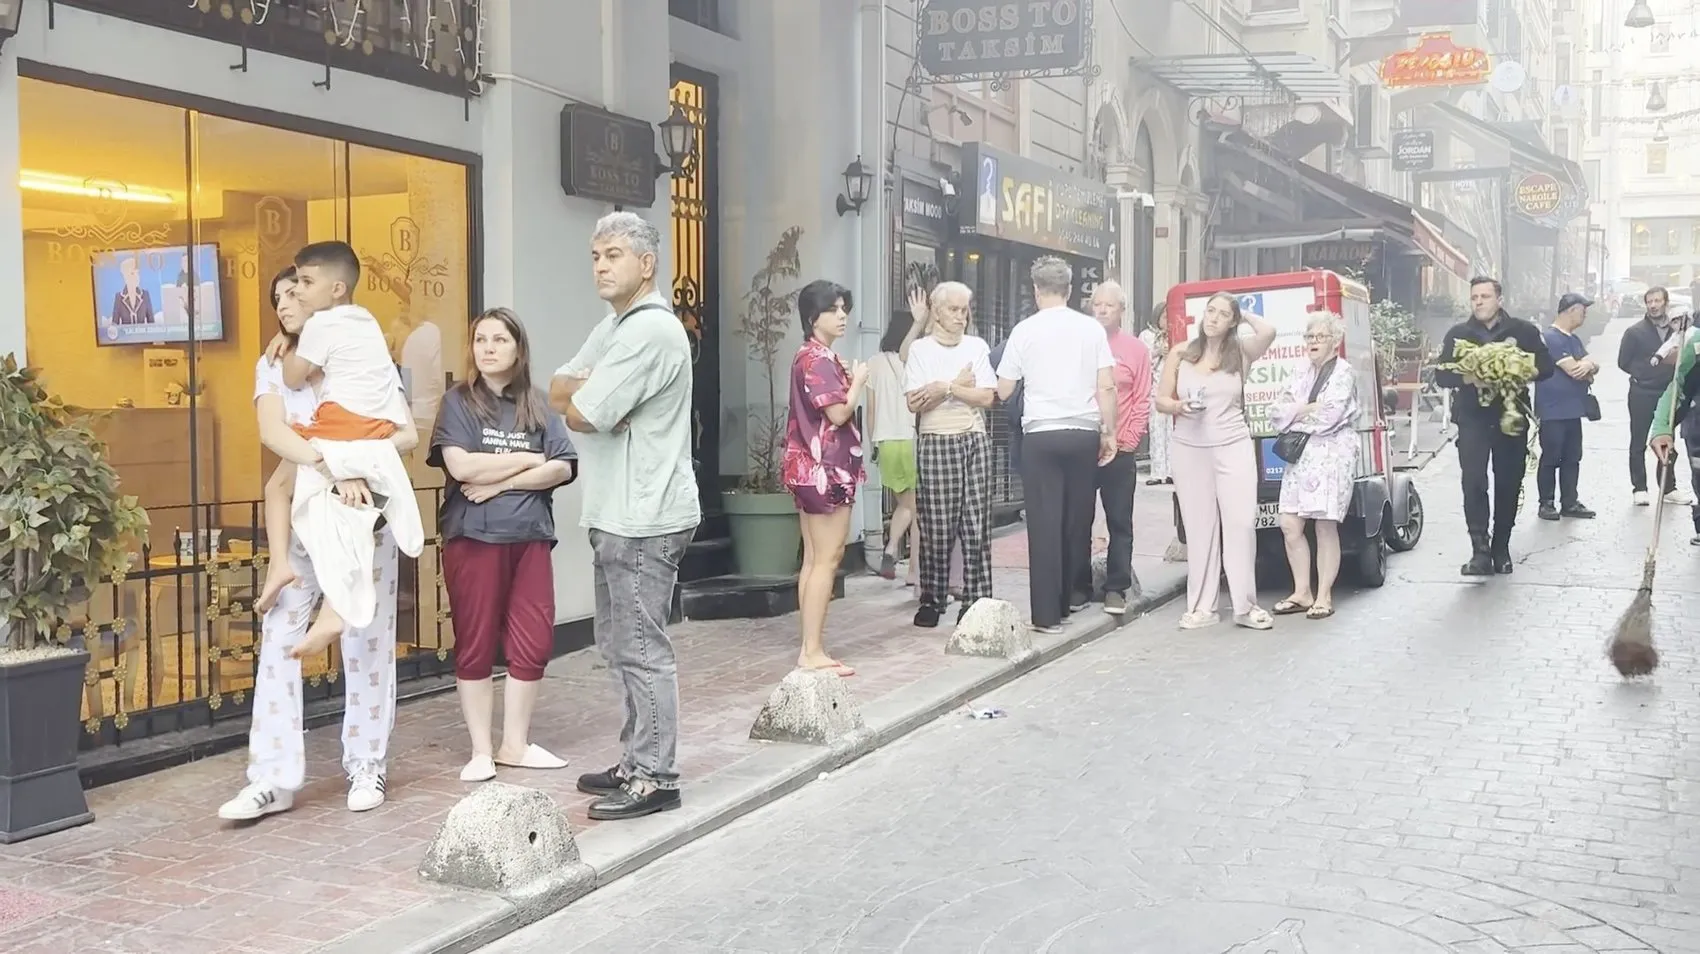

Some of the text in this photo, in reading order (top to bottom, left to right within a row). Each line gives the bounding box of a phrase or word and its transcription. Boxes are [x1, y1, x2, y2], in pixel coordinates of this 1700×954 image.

[927, 1, 1077, 35] BOSS TO
[938, 31, 1065, 62] TAKSİM
[1397, 145, 1432, 155] JORDAN
[1519, 183, 1557, 194] ESCAPE
[1526, 201, 1551, 210] CAFE
[264, 208, 281, 235] B
[399, 229, 411, 251] B
[419, 279, 445, 298] TO
[482, 428, 527, 440] GIRLS JUST
[509, 440, 530, 450] HAVE
[1255, 516, 1276, 528] 782
